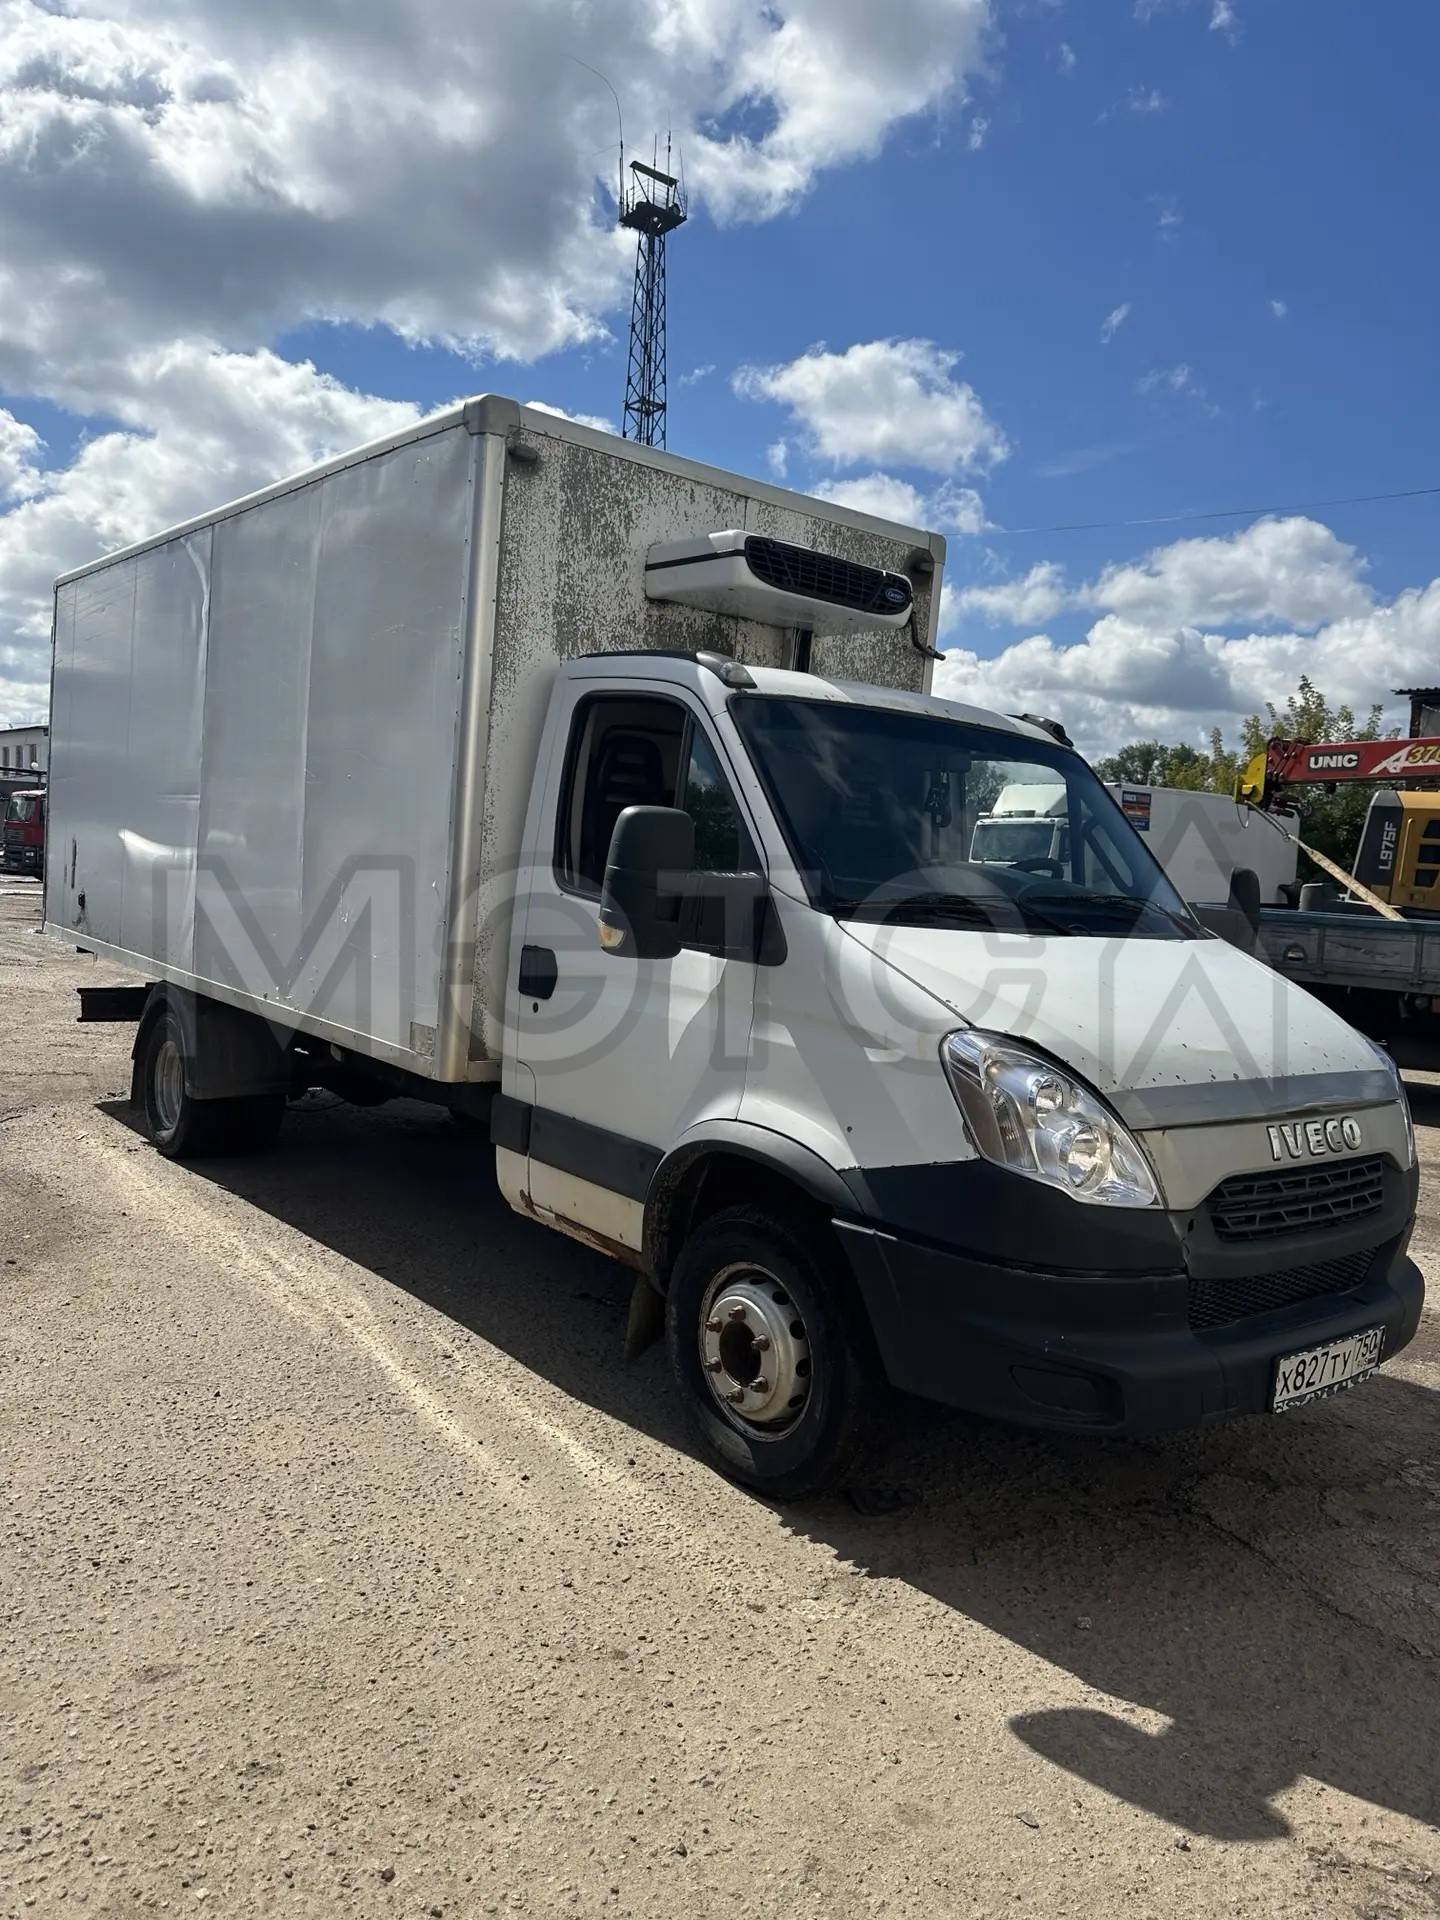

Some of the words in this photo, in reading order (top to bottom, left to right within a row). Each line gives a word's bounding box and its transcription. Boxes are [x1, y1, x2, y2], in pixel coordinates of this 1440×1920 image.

[1309, 754, 1358, 769] UNIC
[1378, 821, 1397, 870] L975F
[1266, 1116, 1361, 1161] IVECO
